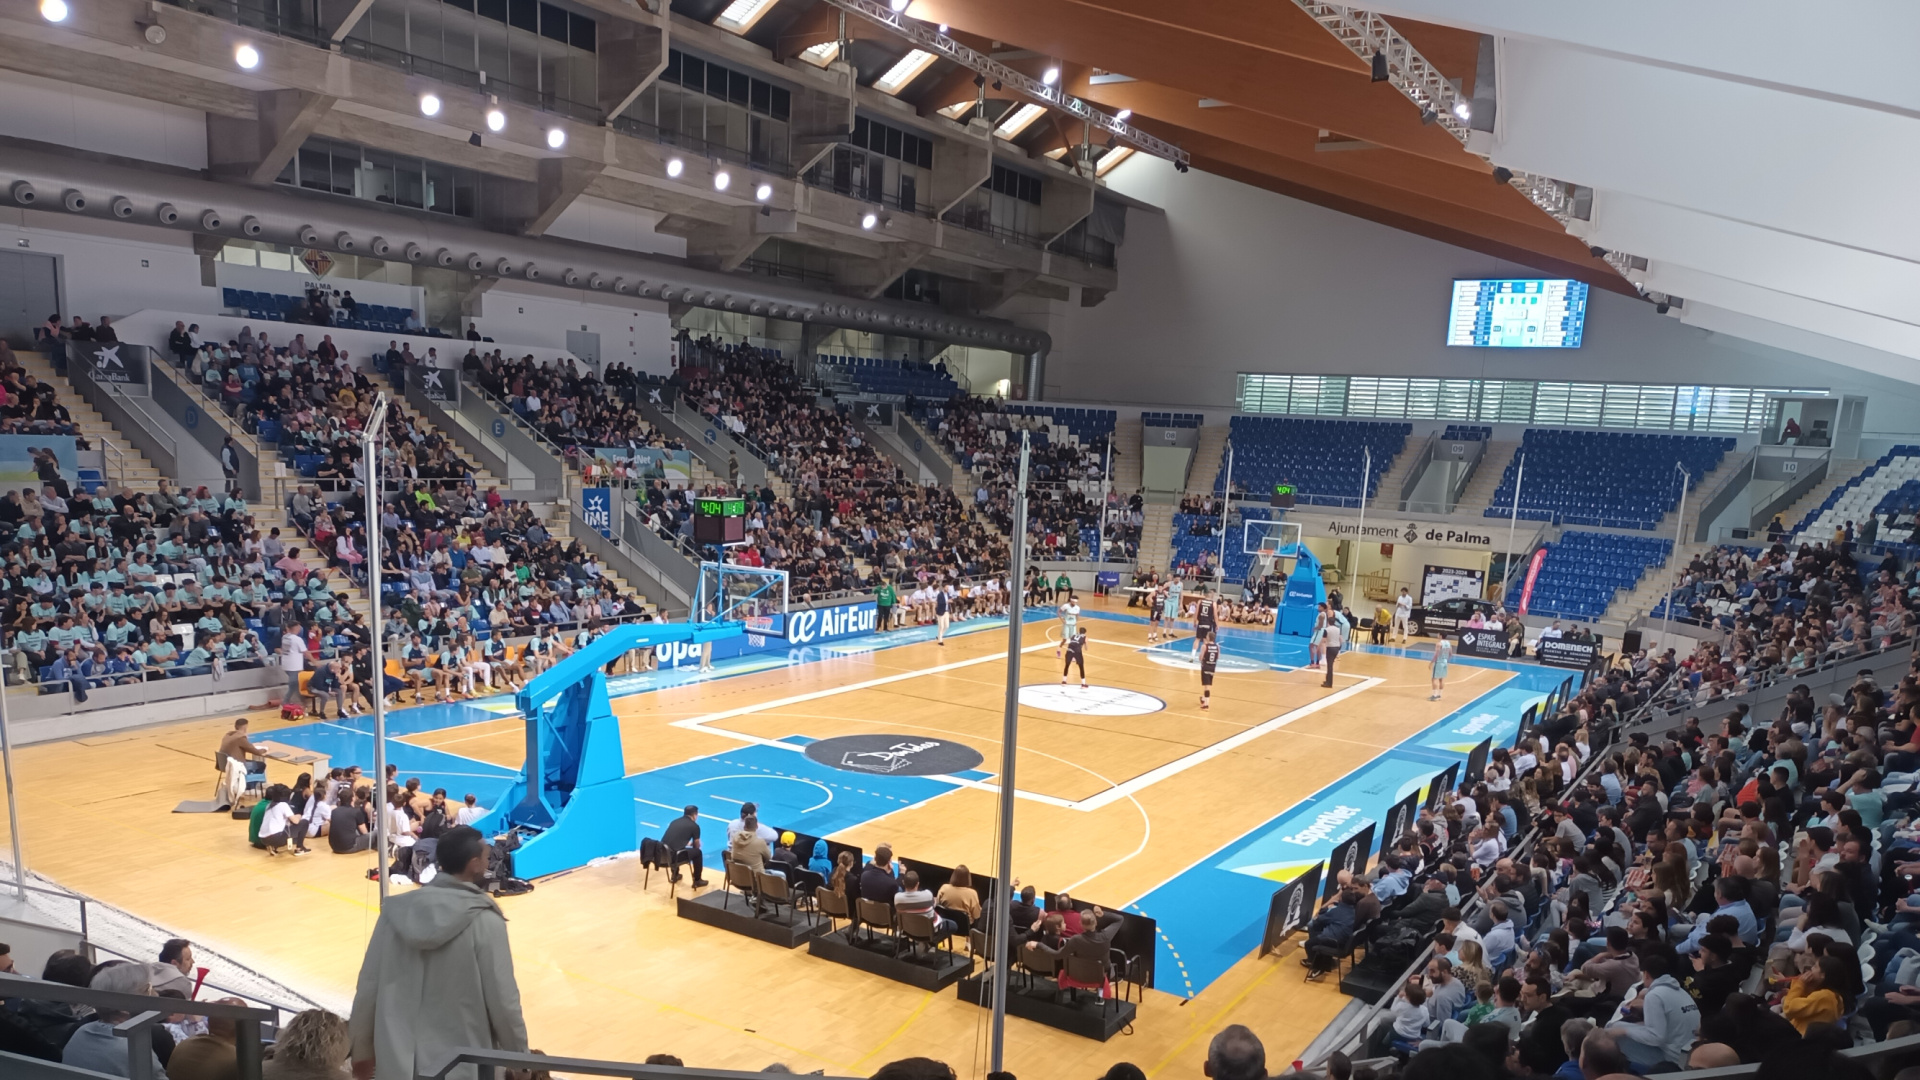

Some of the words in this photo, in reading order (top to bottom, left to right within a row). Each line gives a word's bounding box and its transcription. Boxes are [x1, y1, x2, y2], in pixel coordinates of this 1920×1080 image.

[304, 281, 332, 290] PALMA
[612, 454, 651, 465] EspotNet
[1784, 463, 1796, 471] 10
[701, 501, 721, 514] 4:04
[583, 511, 609, 526] IME
[1328, 521, 1399, 539] Ajuntament
[1425, 529, 1443, 541] de
[1446, 530, 1491, 545] Palma
[1478, 632, 1497, 641] ESPAIS
[1476, 640, 1507, 650] INTEGRALS
[1544, 641, 1593, 654] DOMENECH
[1281, 805, 1362, 847] EsportNet
